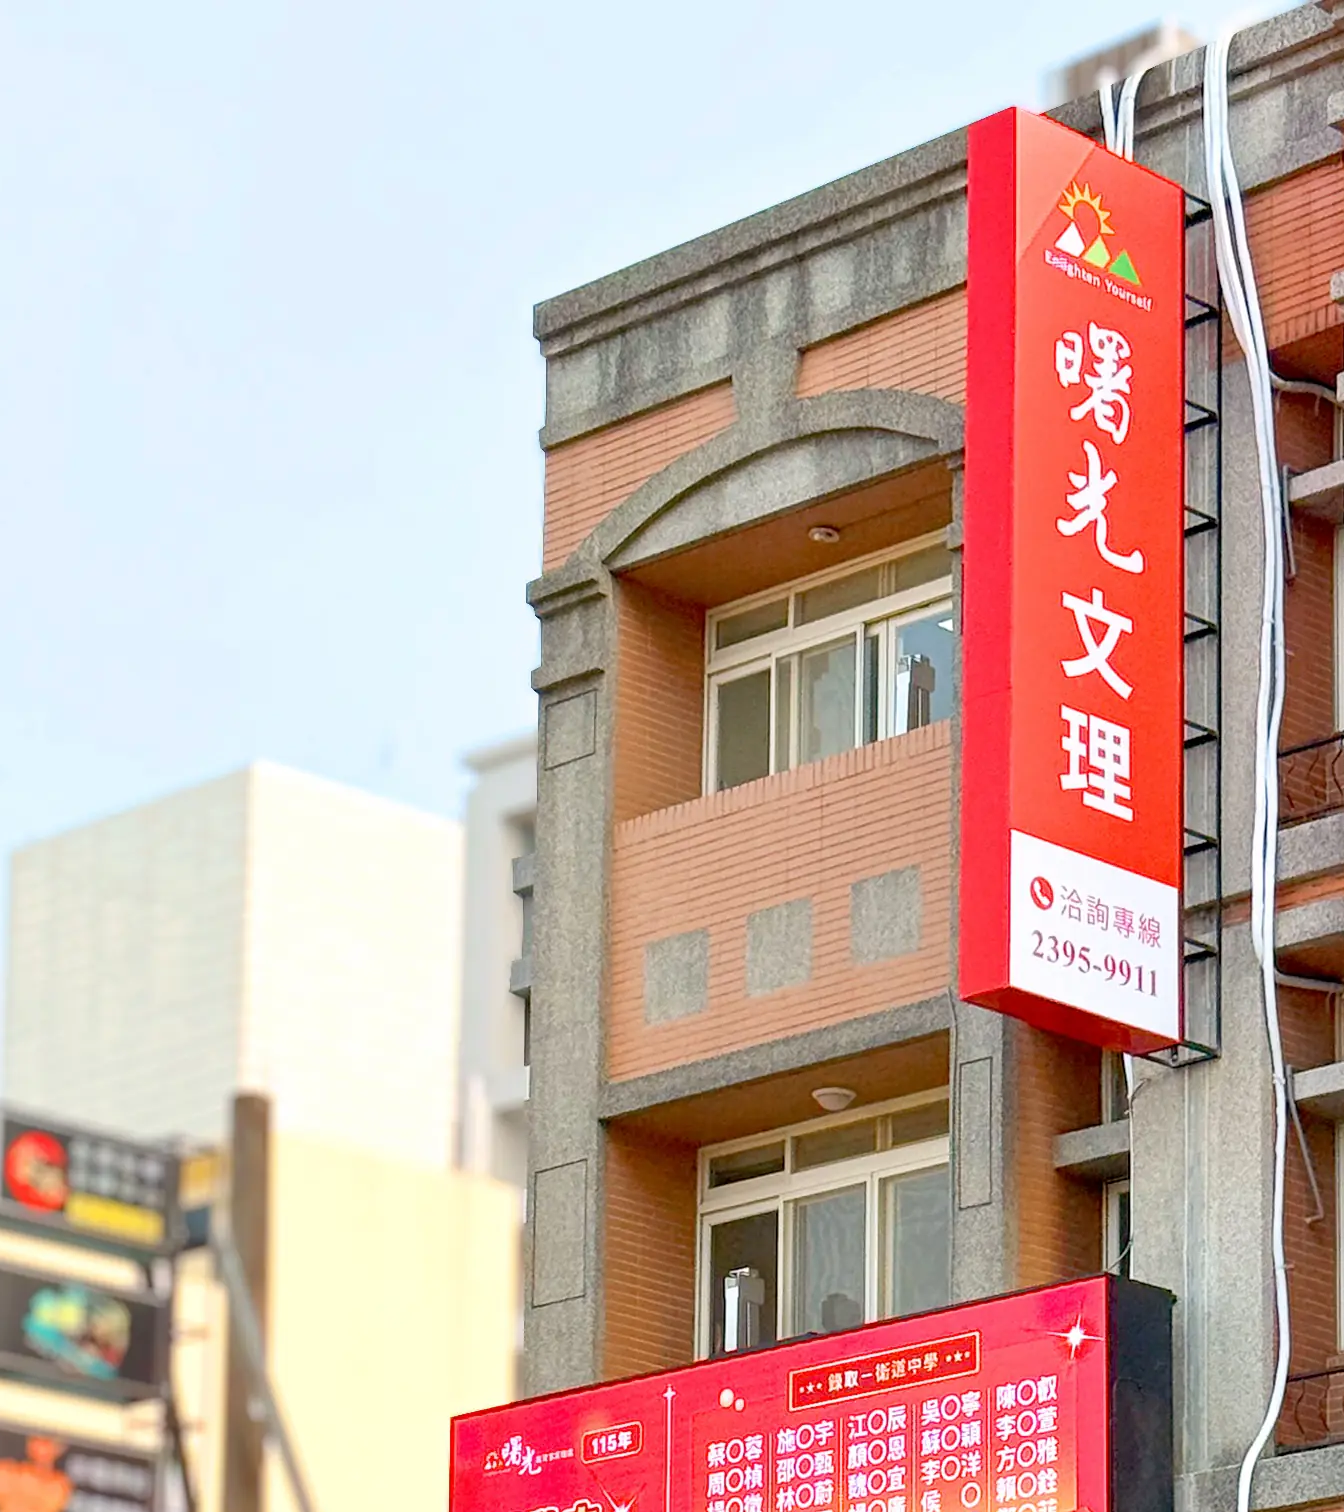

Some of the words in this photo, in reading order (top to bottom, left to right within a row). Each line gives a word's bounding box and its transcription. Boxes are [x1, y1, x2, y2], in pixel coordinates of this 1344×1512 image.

[1104, 279, 1152, 312] Yourself
[1054, 321, 1144, 822] 曙光文理
[1059, 884, 1162, 949] 洽詢專線
[1031, 929, 1159, 998] 2395-9911
[591, 1431, 633, 1455] 115年
